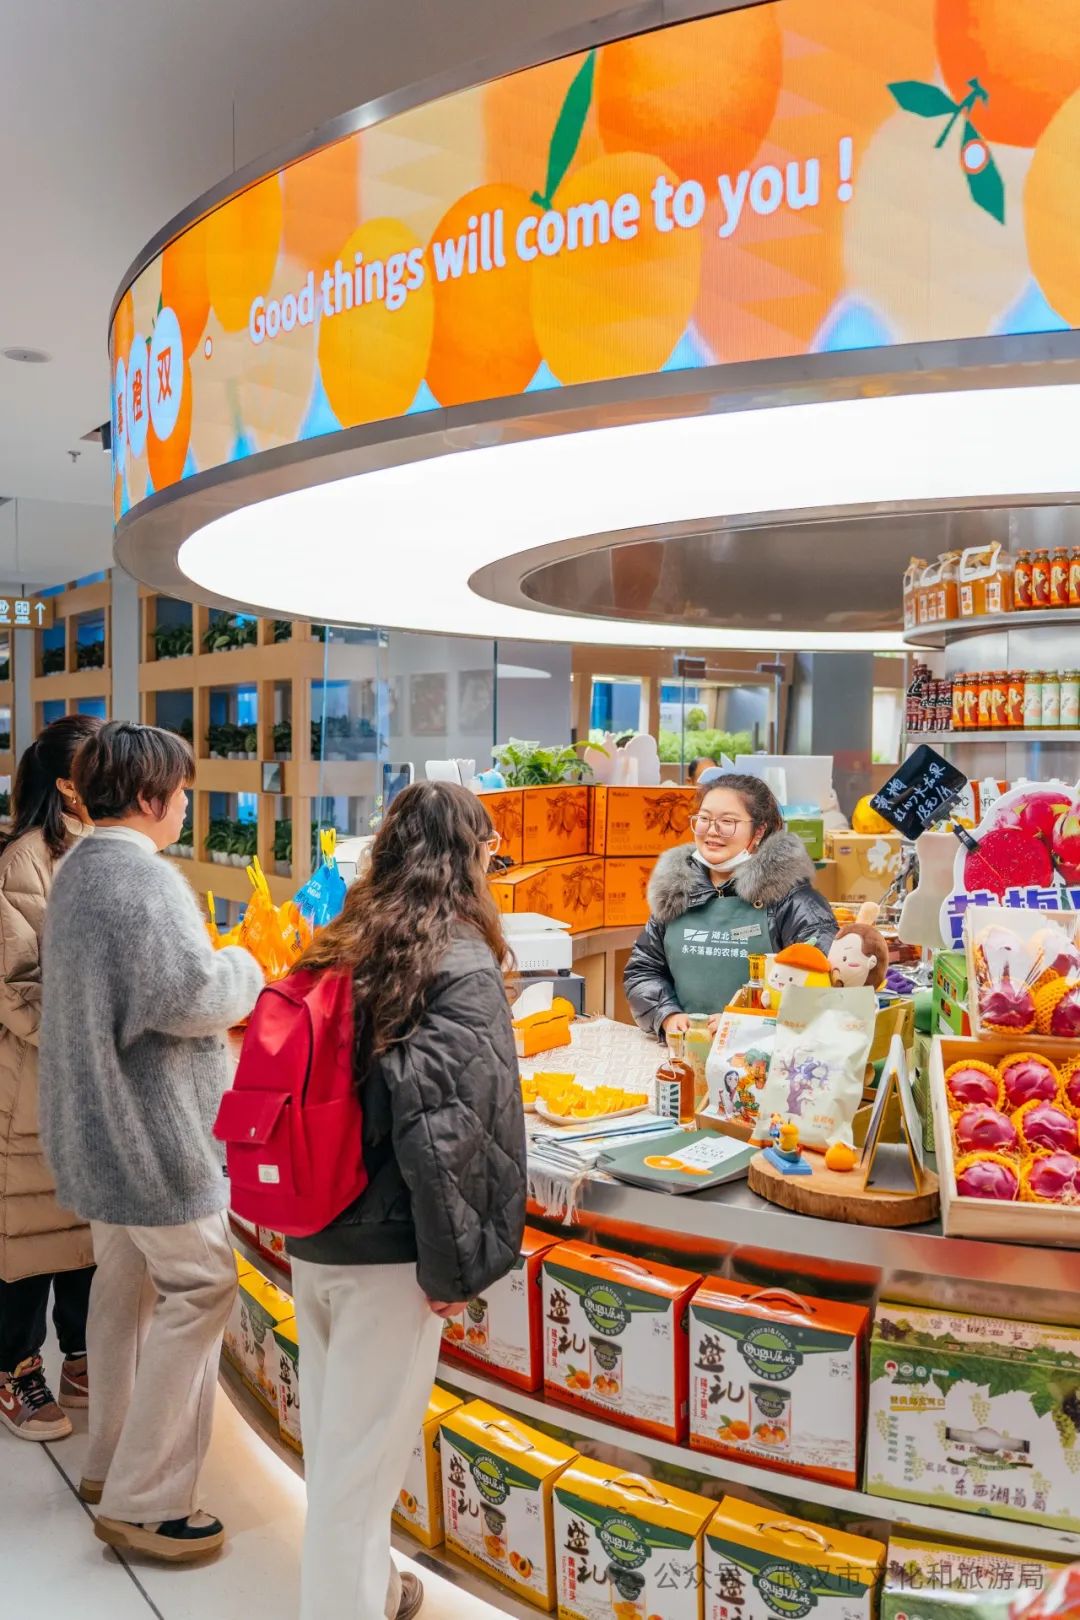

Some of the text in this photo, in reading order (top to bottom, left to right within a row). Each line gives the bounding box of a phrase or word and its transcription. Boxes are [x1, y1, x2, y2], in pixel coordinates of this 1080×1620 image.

[250, 271, 314, 344] Good
[320, 247, 425, 317] things
[433, 209, 507, 281] will
[515, 193, 640, 261] come
[651, 175, 705, 232] to
[717, 158, 820, 238] you
[954, 1479, 1047, 1513] 东西湖葡萄
